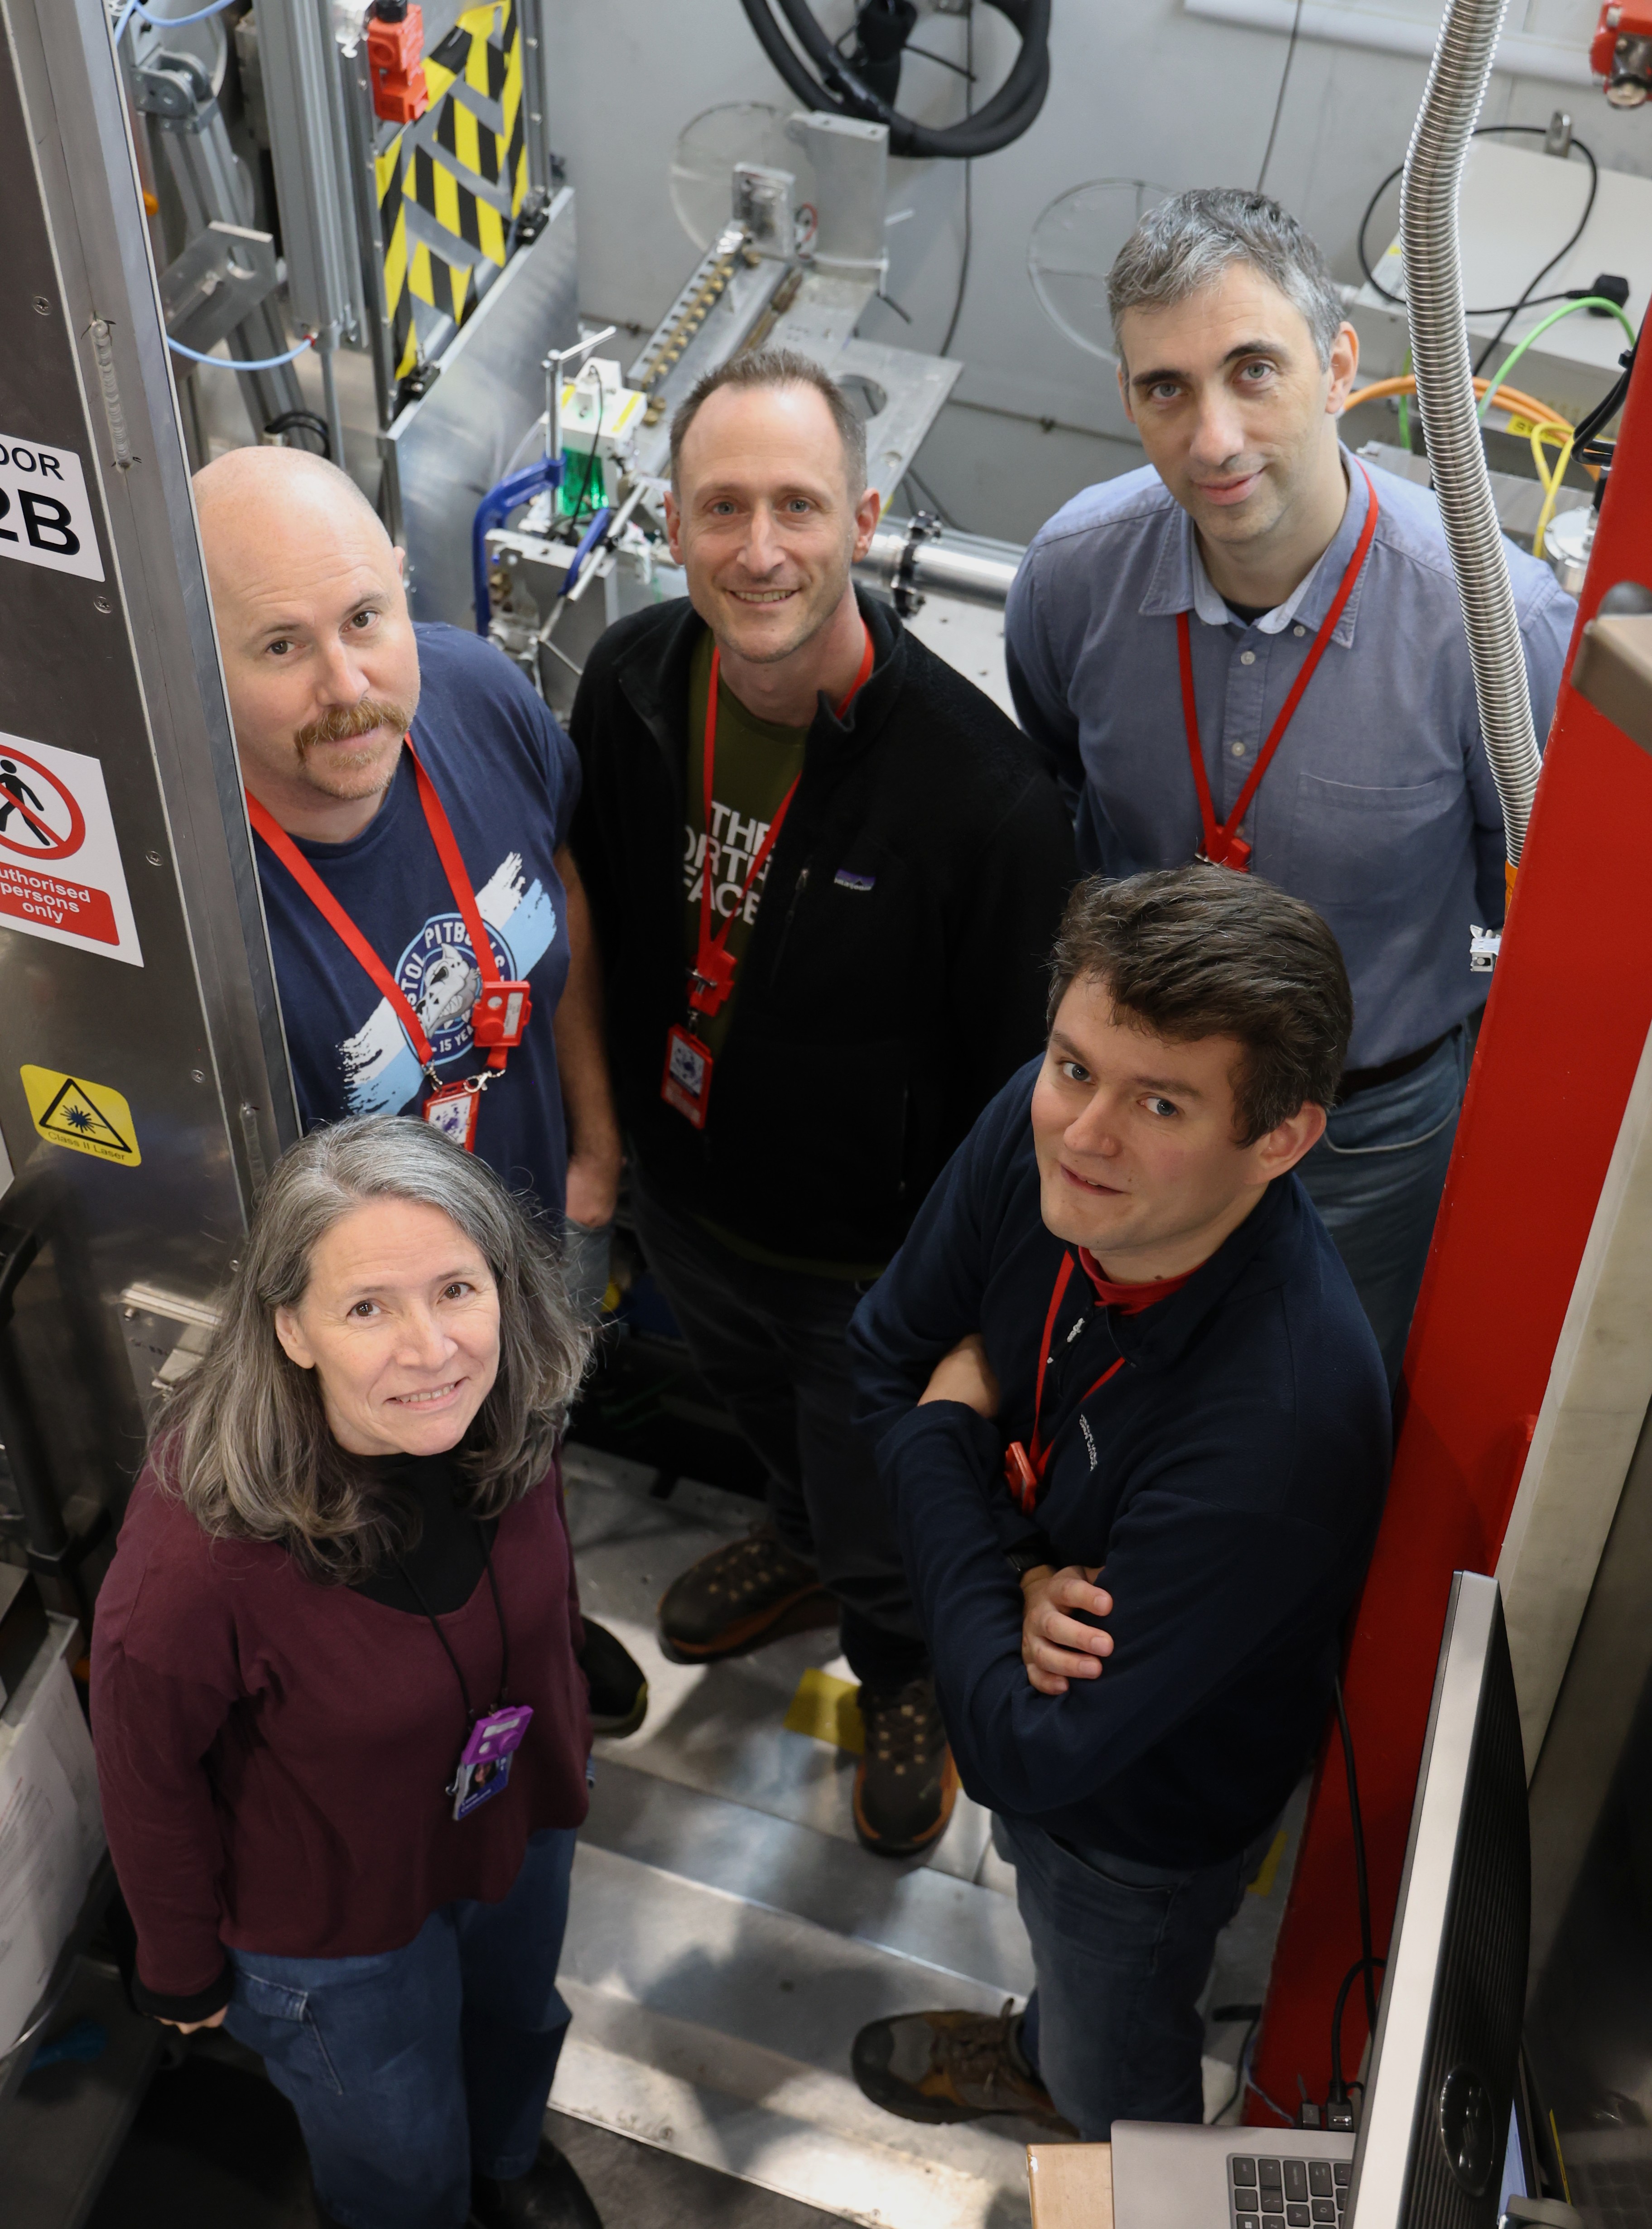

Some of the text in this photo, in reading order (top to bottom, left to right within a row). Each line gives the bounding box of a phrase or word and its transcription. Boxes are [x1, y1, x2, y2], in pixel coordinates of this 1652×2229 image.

[0, 882, 80, 913] persons
[22, 902, 63, 924] only
[439, 1025, 474, 1052] 15 YEA
[48, 1131, 80, 1147] Class
[94, 1145, 125, 1160] Laser
